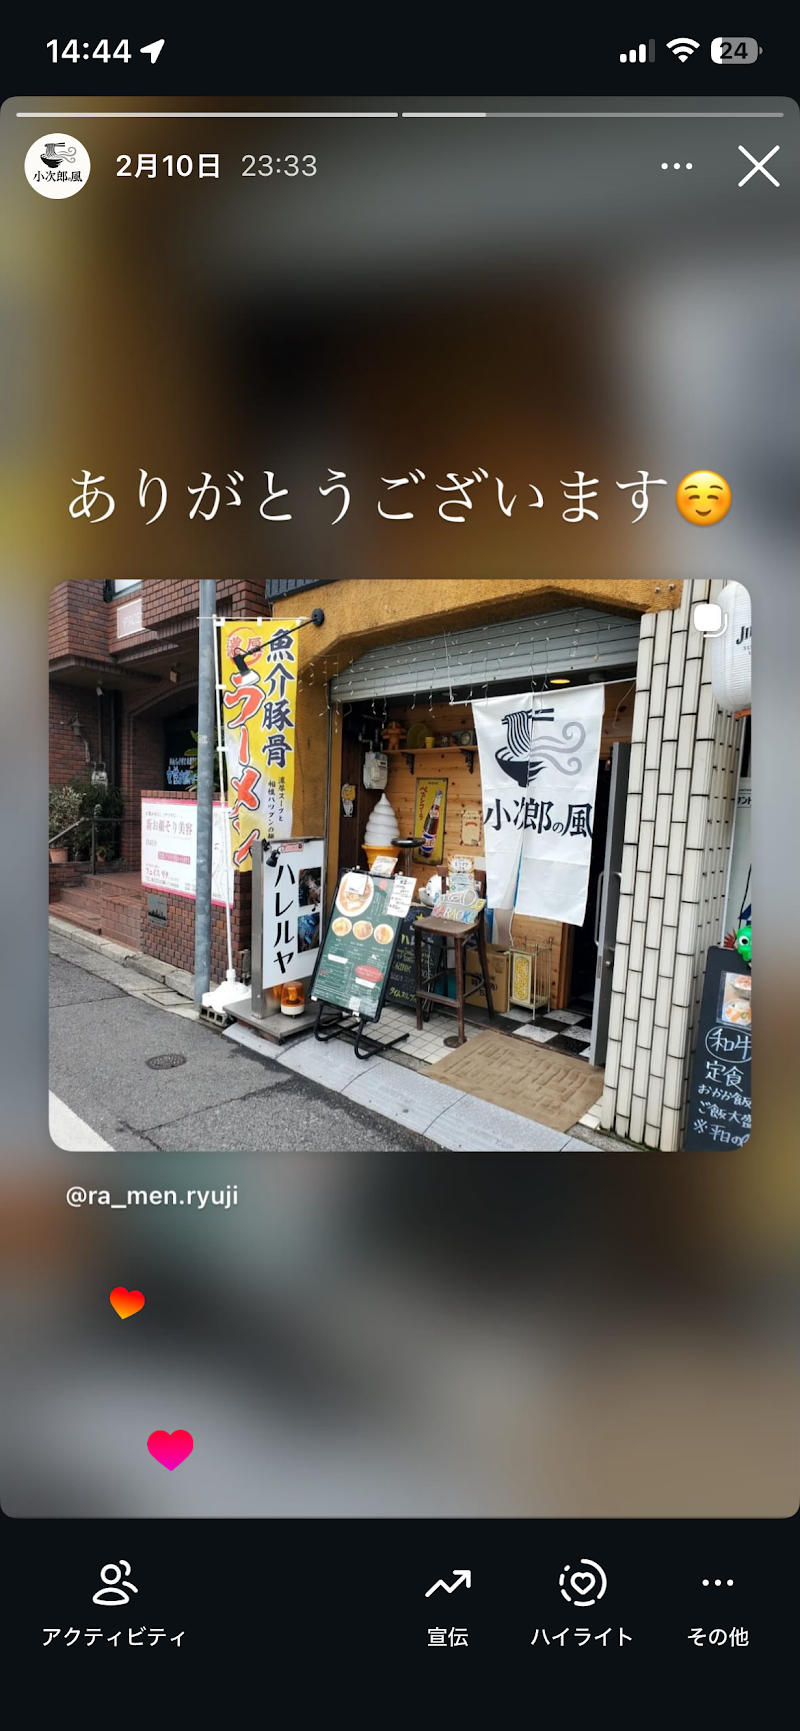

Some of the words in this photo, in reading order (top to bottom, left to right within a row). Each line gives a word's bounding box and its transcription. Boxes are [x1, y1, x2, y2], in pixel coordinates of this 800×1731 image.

[262, 629, 295, 769] 魚介豚骨
[273, 864, 296, 975] ハレルヤ
[704, 1060, 744, 1092] 定食
